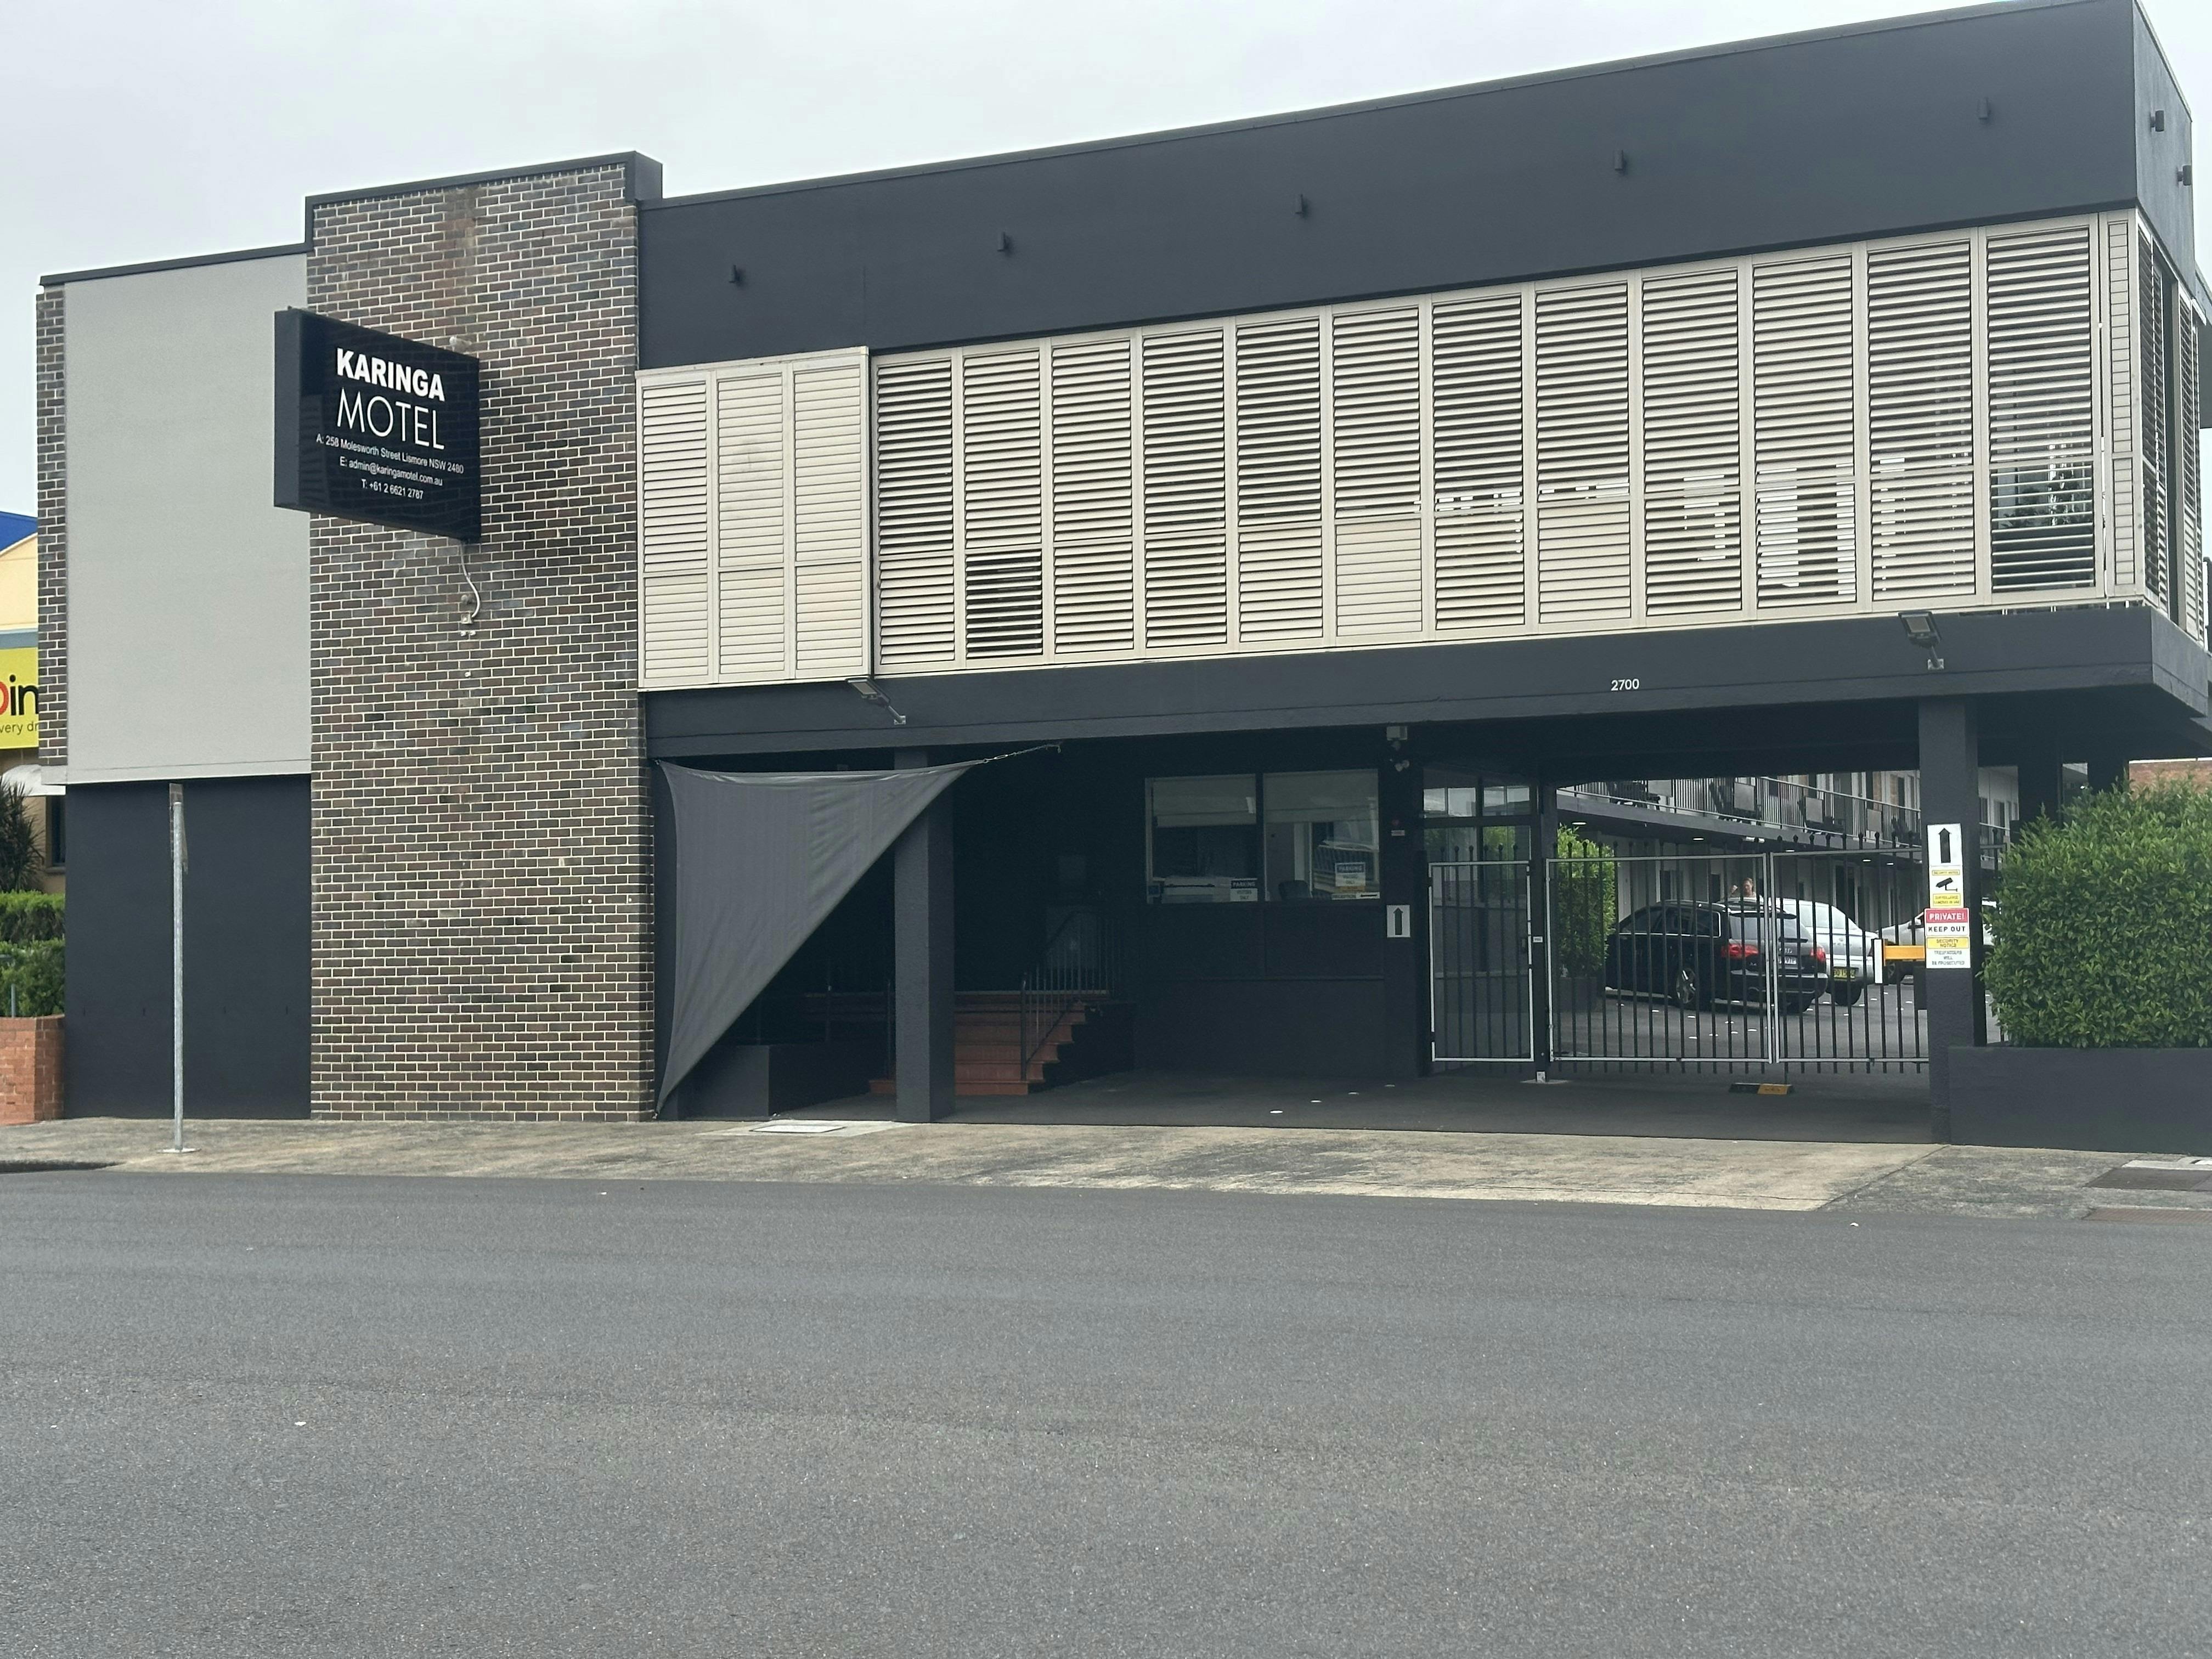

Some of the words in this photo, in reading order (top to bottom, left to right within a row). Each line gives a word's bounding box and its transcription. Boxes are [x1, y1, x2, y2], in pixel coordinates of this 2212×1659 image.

[337, 347, 445, 402] KARINGA
[337, 387, 444, 450] MOTEL
[316, 433, 324, 444] A:
[326, 435, 339, 447] 258
[341, 438, 379, 456] Molesworth
[380, 447, 400, 461] Street
[402, 452, 427, 466] Lismore
[429, 458, 446, 470] NSW
[447, 462, 464, 474] 2480
[340, 456, 347, 467] E:
[349, 459, 443, 486] admin@karingamotel.com.au
[361, 478, 368, 489] T:
[370, 481, 381, 492] +61
[384, 483, 389, 493] 2
[390, 484, 405, 496] 6621
[407, 488, 424, 499] 2787
[1611, 678, 1640, 691] 2700
[1929, 912, 1965, 921] PRIVATE!
